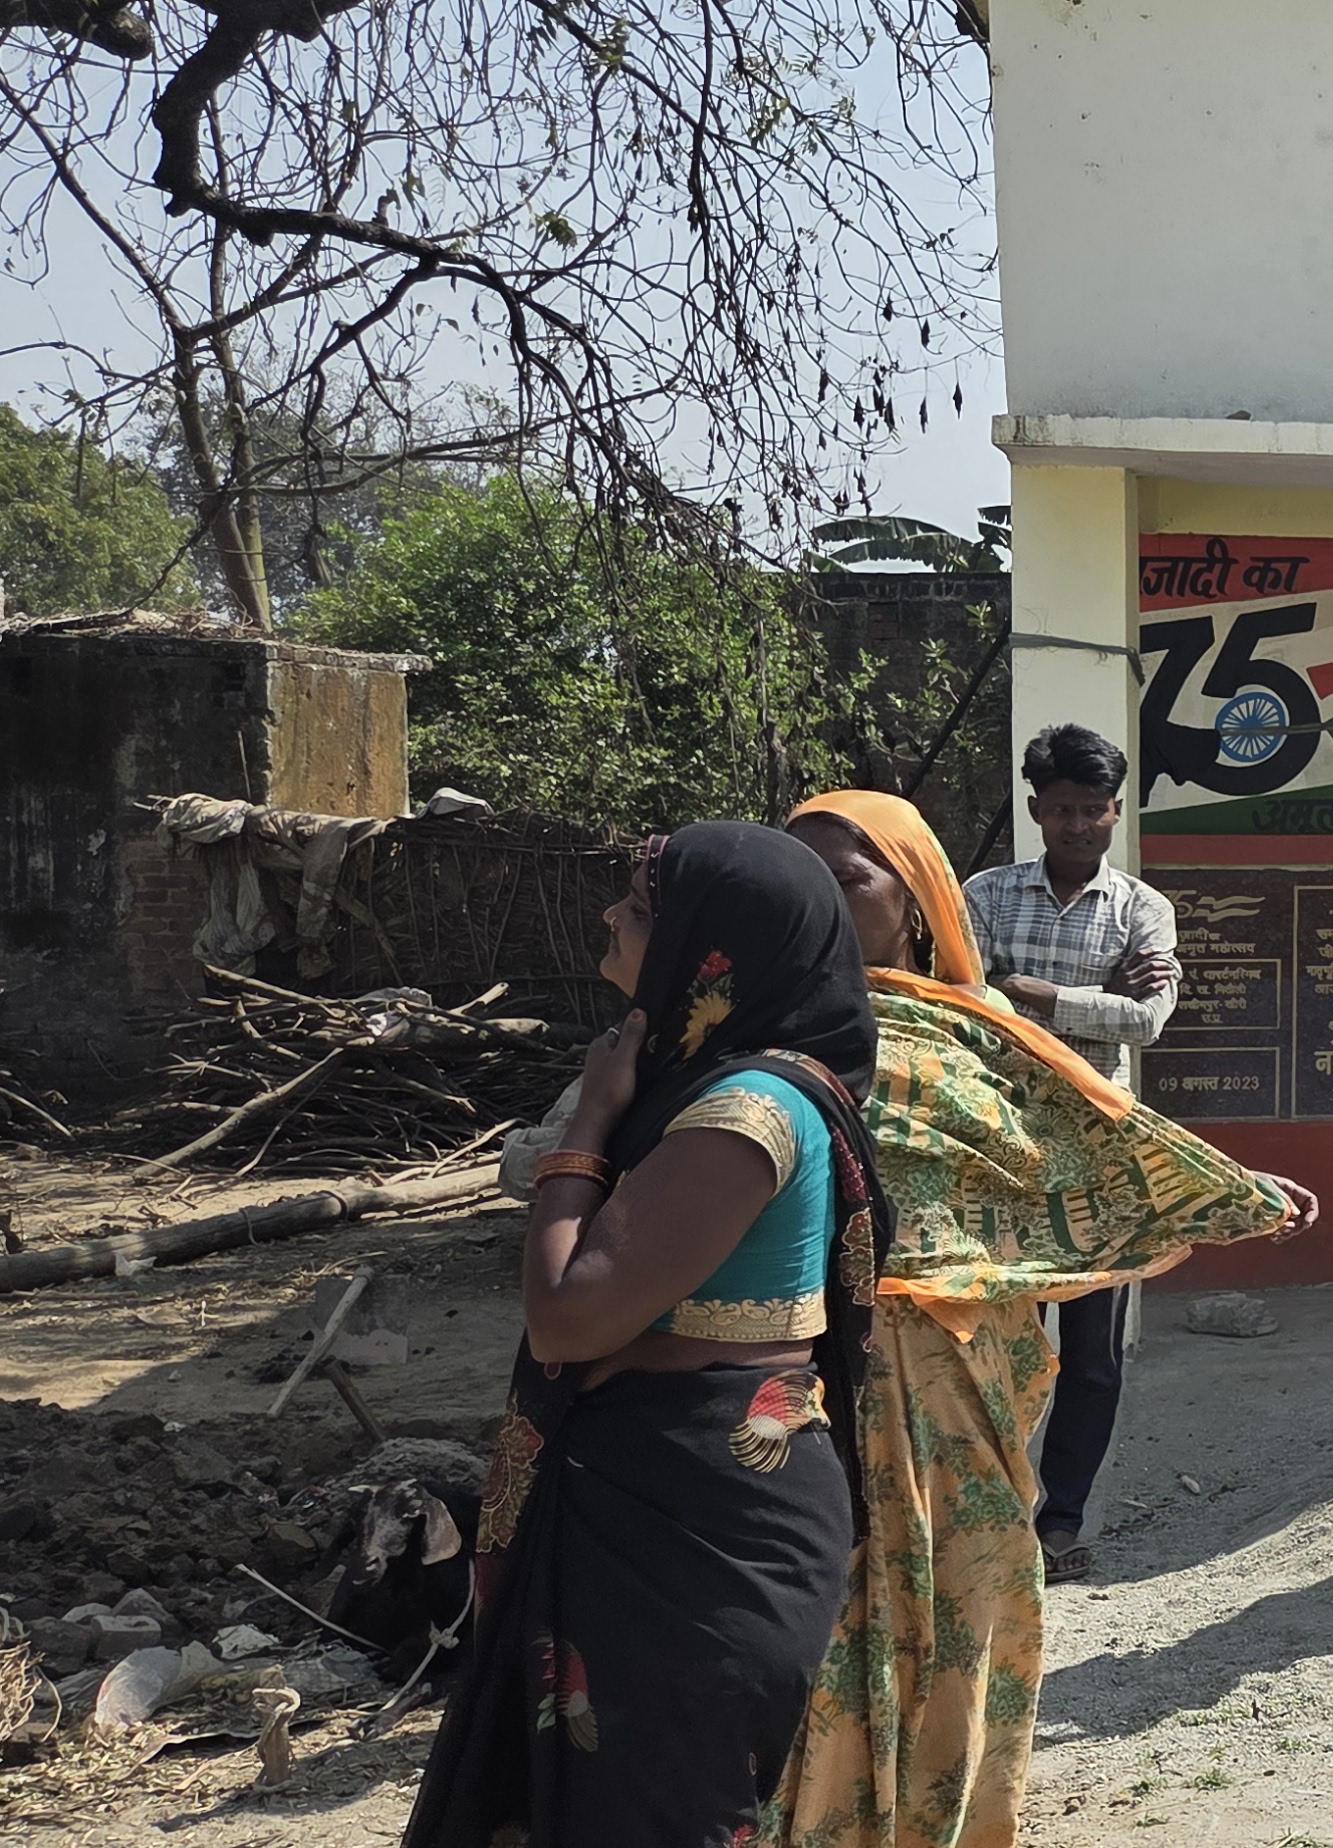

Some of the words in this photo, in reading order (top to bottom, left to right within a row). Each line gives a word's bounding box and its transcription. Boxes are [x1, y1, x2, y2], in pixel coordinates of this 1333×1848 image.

[1139, 539, 1240, 599] जादी
[1243, 556, 1310, 593] का
[1158, 1076, 1178, 1092] 09
[1180, 1075, 1220, 1093] अगस्त
[1221, 1075, 1260, 1091] 2023
